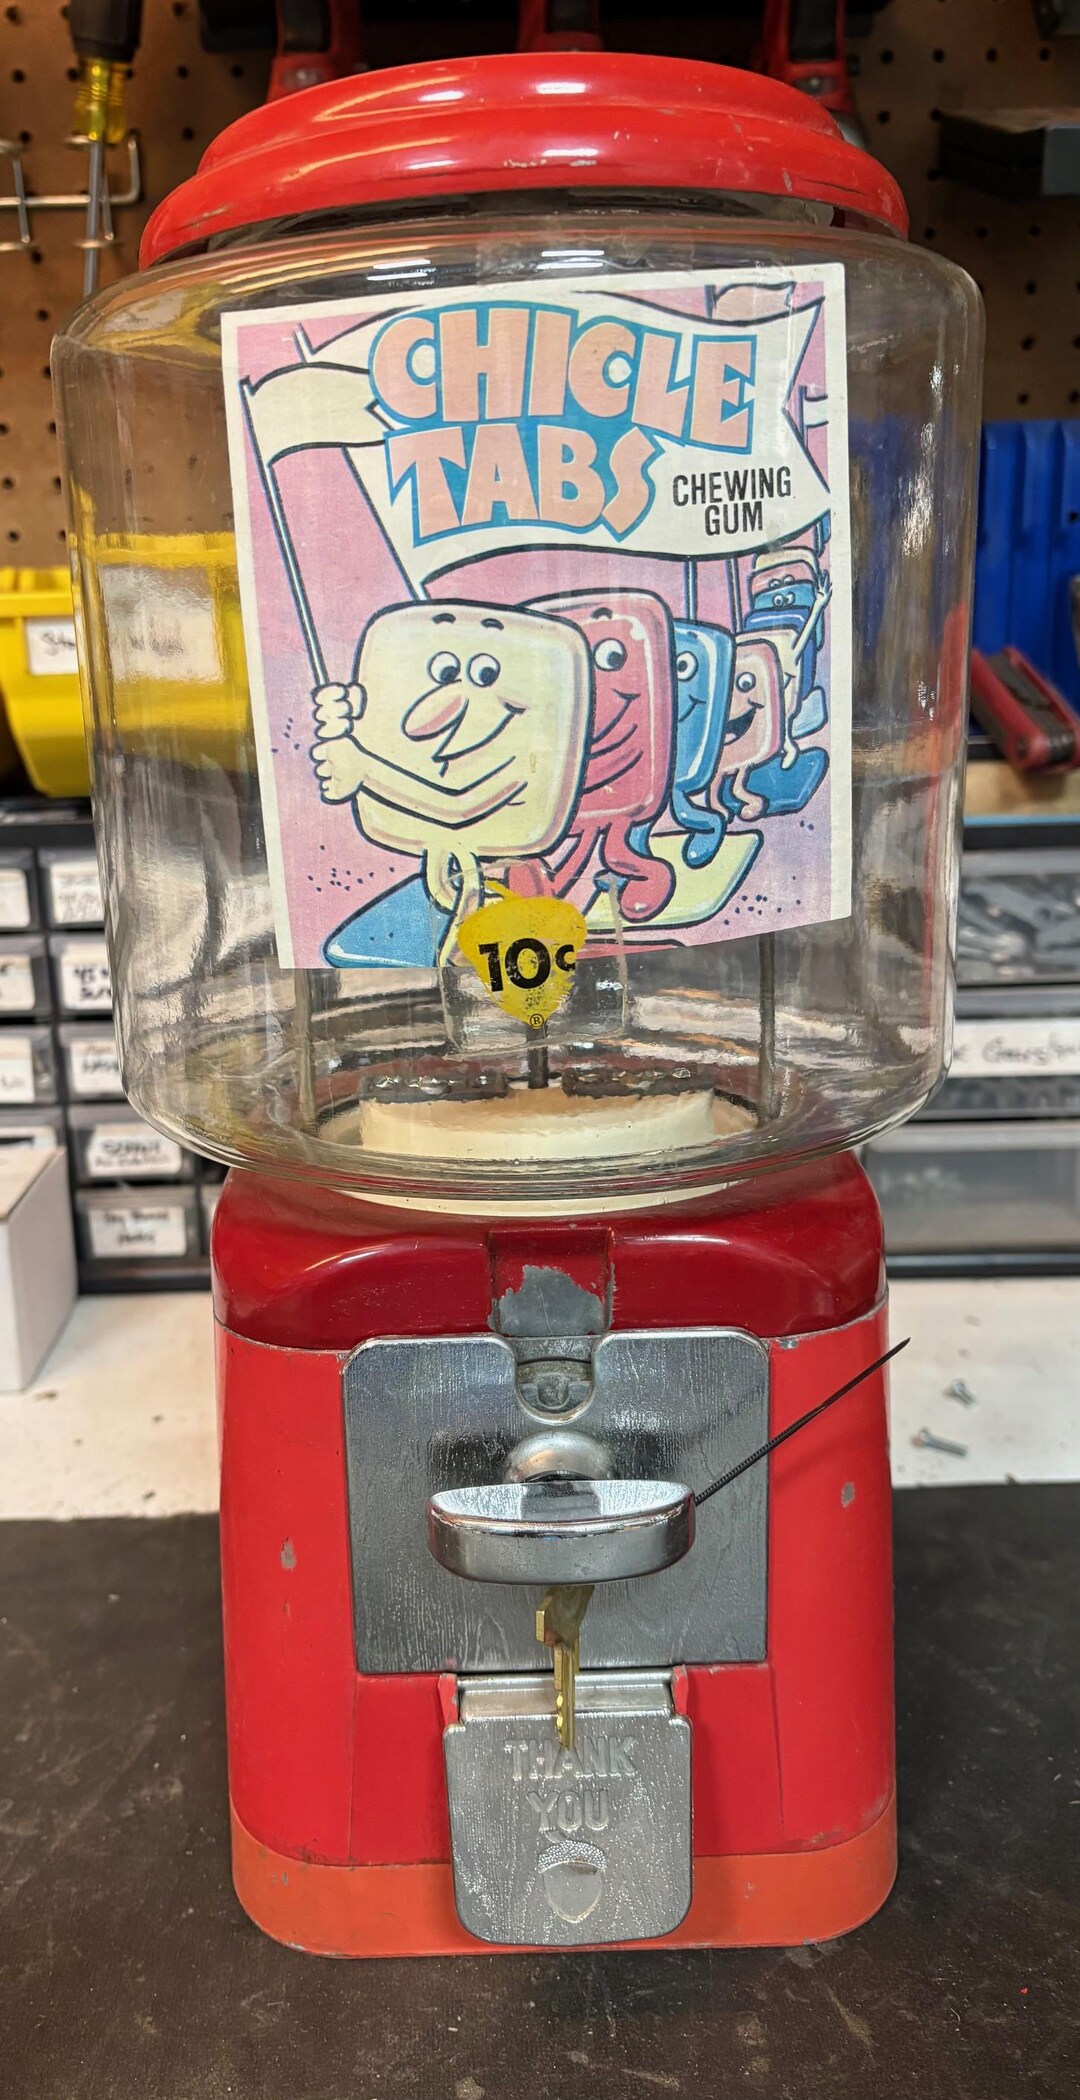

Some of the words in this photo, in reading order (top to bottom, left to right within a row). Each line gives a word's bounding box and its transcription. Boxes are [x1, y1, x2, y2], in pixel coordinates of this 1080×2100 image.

[371, 305, 756, 451] CHICLE
[388, 423, 659, 540] TABS
[673, 466, 791, 507] CHEWING
[705, 501, 763, 536] GUM
[503, 1735, 638, 1781] THANK
[526, 1789, 610, 1833] YOU
